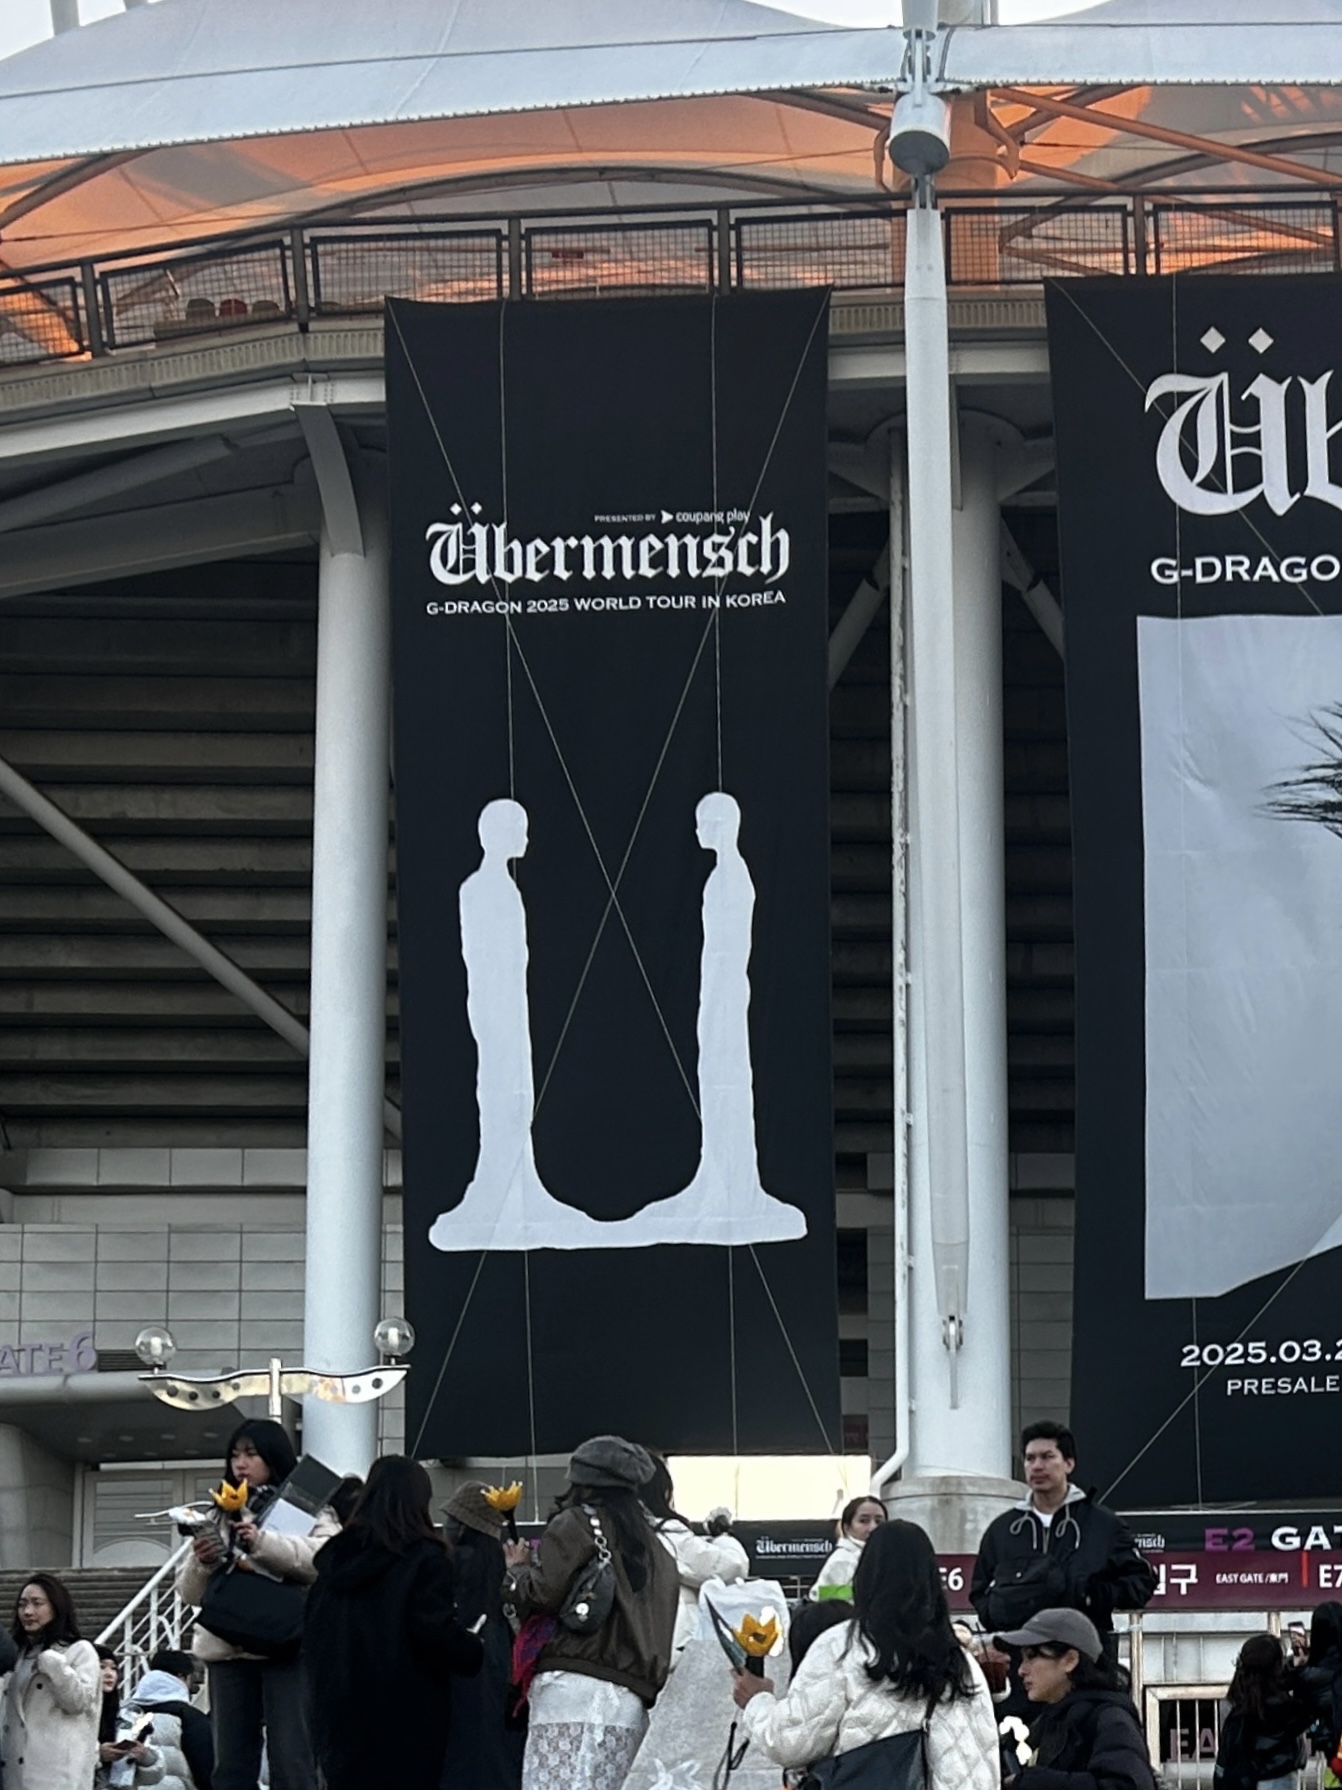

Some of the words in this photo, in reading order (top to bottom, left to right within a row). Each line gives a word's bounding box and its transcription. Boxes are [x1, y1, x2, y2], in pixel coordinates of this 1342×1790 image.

[676, 512, 724, 524] coupang
[425, 502, 791, 584] Übermensch
[427, 601, 521, 614] G-DRAGON
[527, 599, 569, 612] 2025
[574, 597, 641, 610] WORLD
[646, 596, 695, 608] TOUR
[703, 596, 720, 608] IN
[726, 591, 785, 607] KOREA
[1228, 1376, 1339, 1395] PRESALE
[1205, 1527, 1256, 1551] E2
